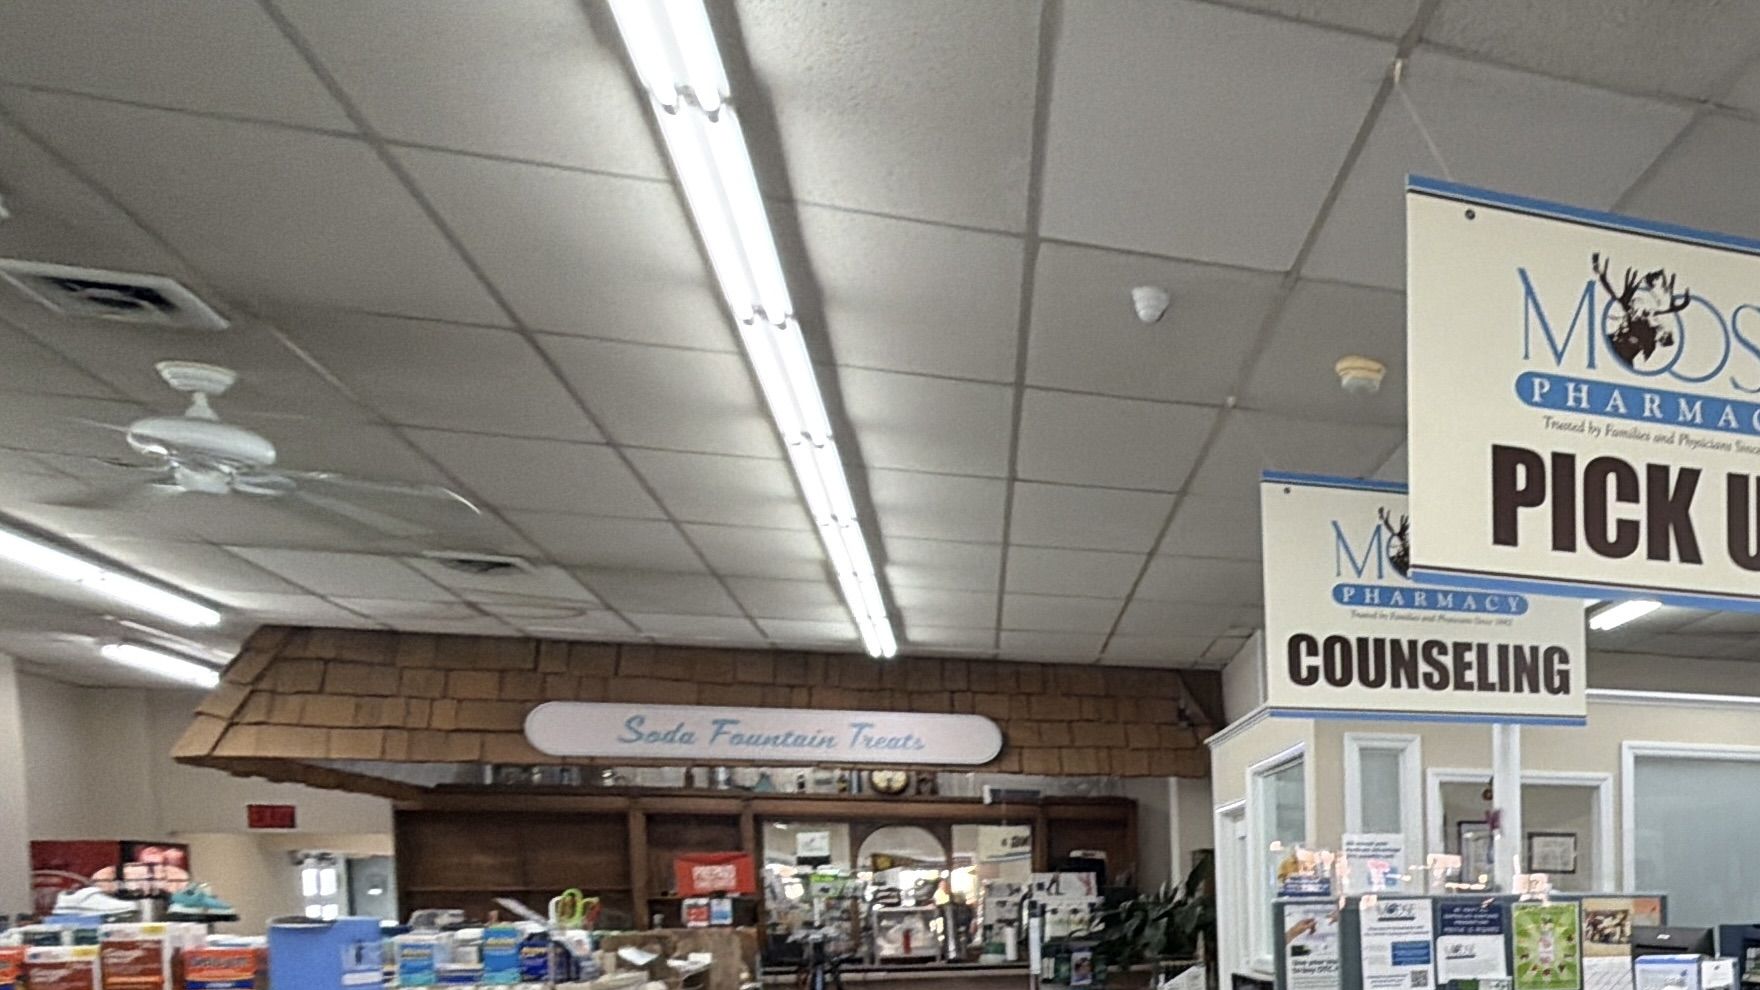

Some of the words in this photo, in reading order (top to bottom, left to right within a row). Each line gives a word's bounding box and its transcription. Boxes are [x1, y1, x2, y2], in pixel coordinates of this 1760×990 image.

[1543, 415, 1586, 434] Trusted
[1588, 420, 1602, 438] by
[1605, 425, 1651, 442] Families
[1491, 443, 1703, 565] PICK
[1341, 587, 1522, 613] PHARMACY
[1287, 633, 1570, 695] COUNSELING
[617, 714, 696, 745] Soda
[708, 718, 839, 751] Fountain
[849, 722, 926, 752] Treats
